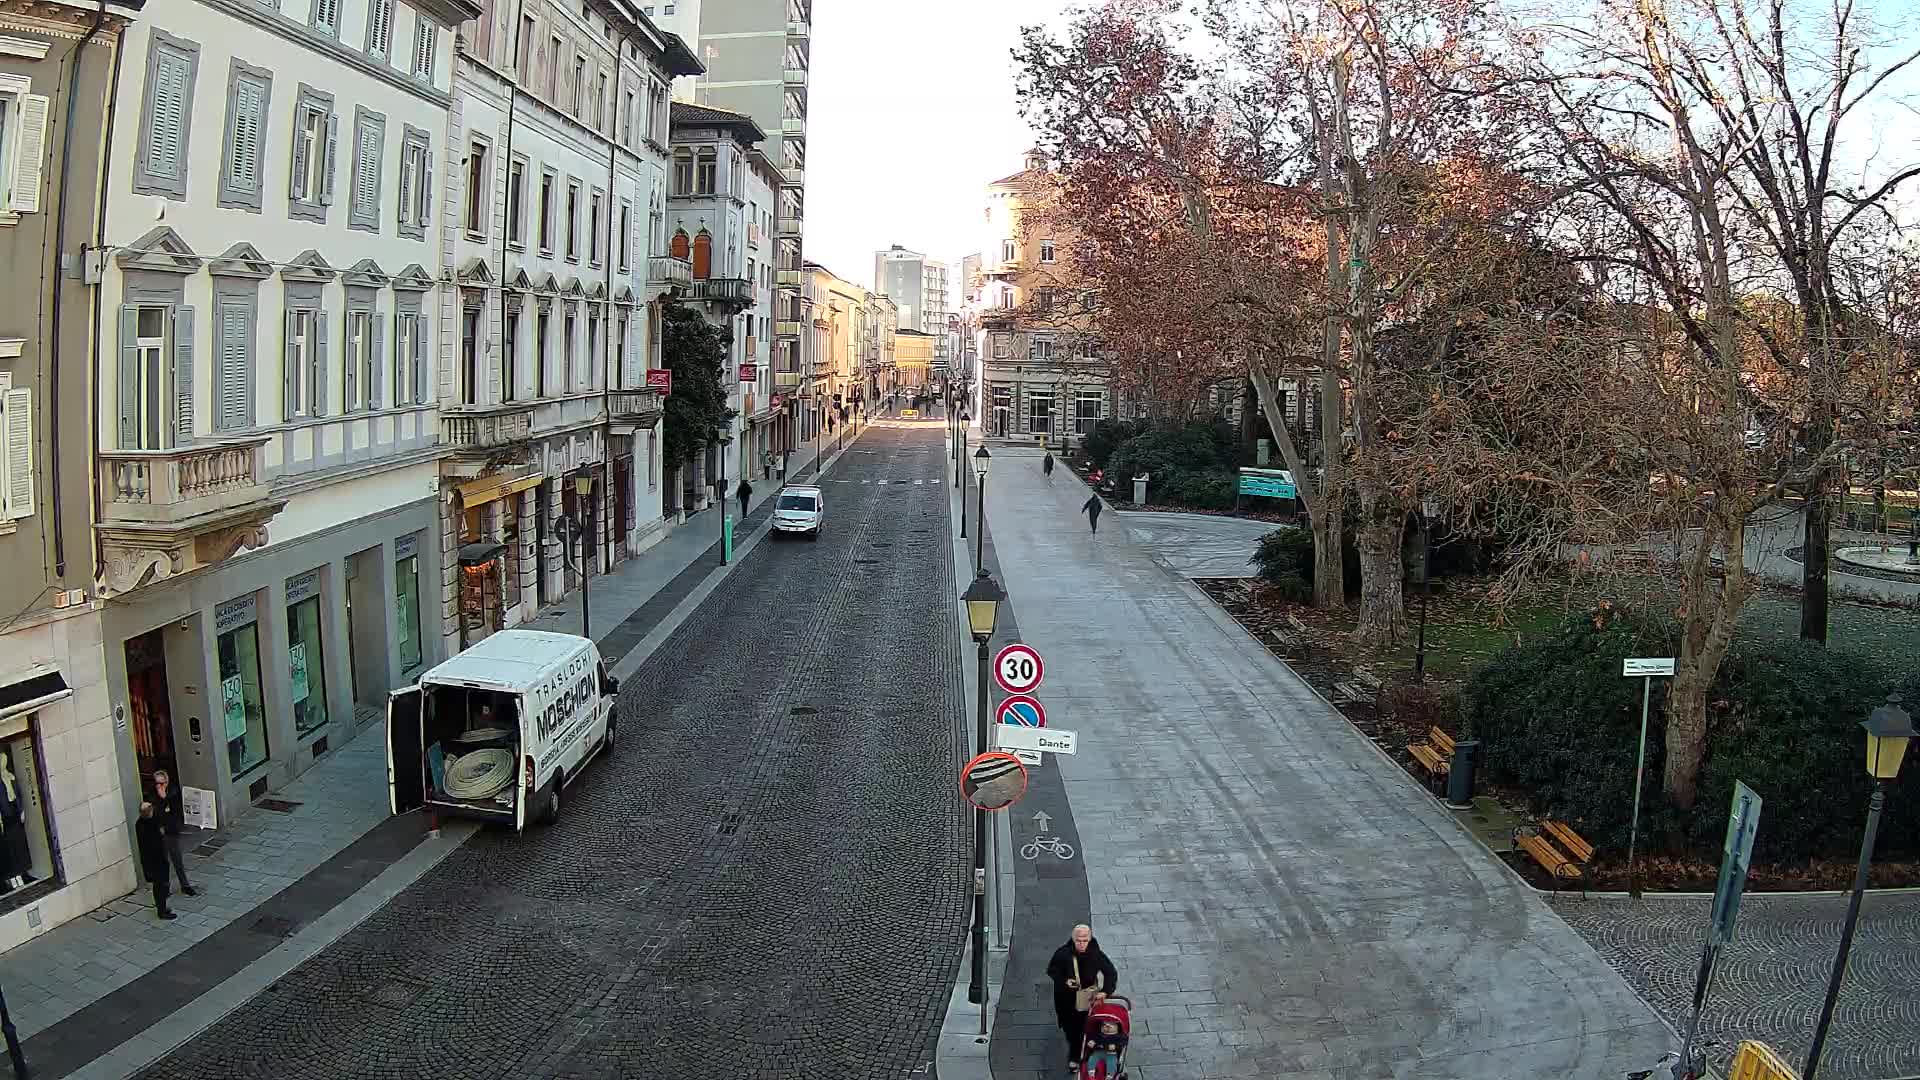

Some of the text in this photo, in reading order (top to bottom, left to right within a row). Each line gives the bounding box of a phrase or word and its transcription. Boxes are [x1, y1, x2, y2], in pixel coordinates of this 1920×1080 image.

[536, 650, 592, 703] TRASLOCHI
[1006, 658, 1034, 681] 30
[224, 676, 241, 700] 130
[535, 671, 597, 744] MOSCHION
[1039, 738, 1071, 749] Dante
